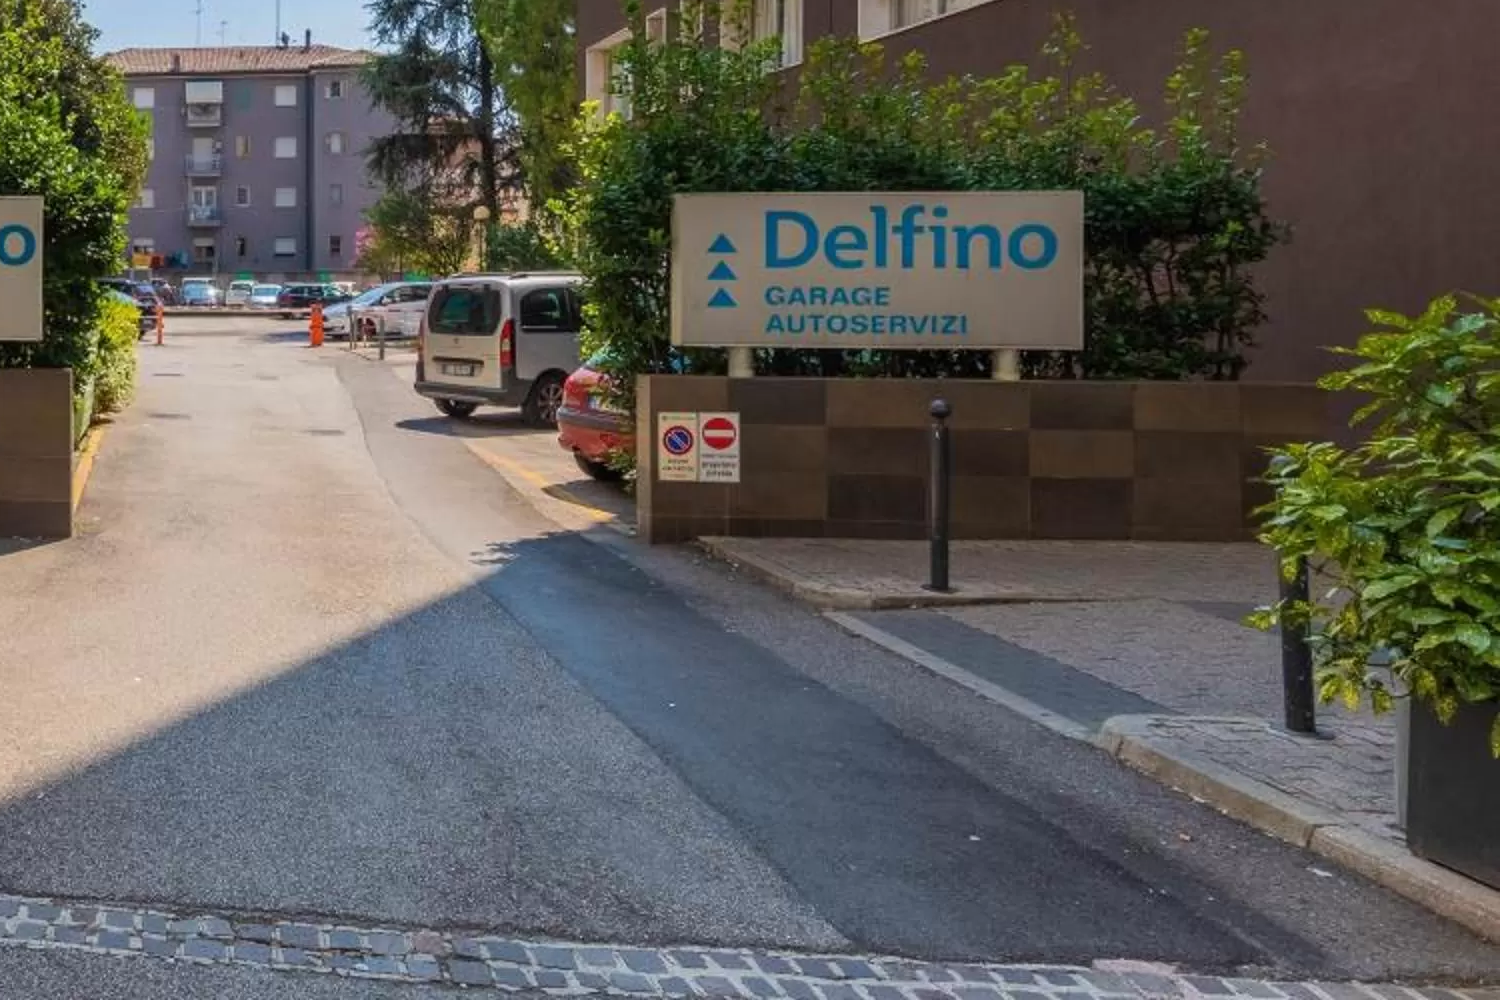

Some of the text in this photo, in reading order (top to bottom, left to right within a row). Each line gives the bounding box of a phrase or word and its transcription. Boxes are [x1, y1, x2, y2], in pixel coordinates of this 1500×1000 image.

[764, 204, 1058, 270] Delfino
[765, 285, 891, 307] GARAGE
[766, 313, 968, 335] AUTOSERVIZI
